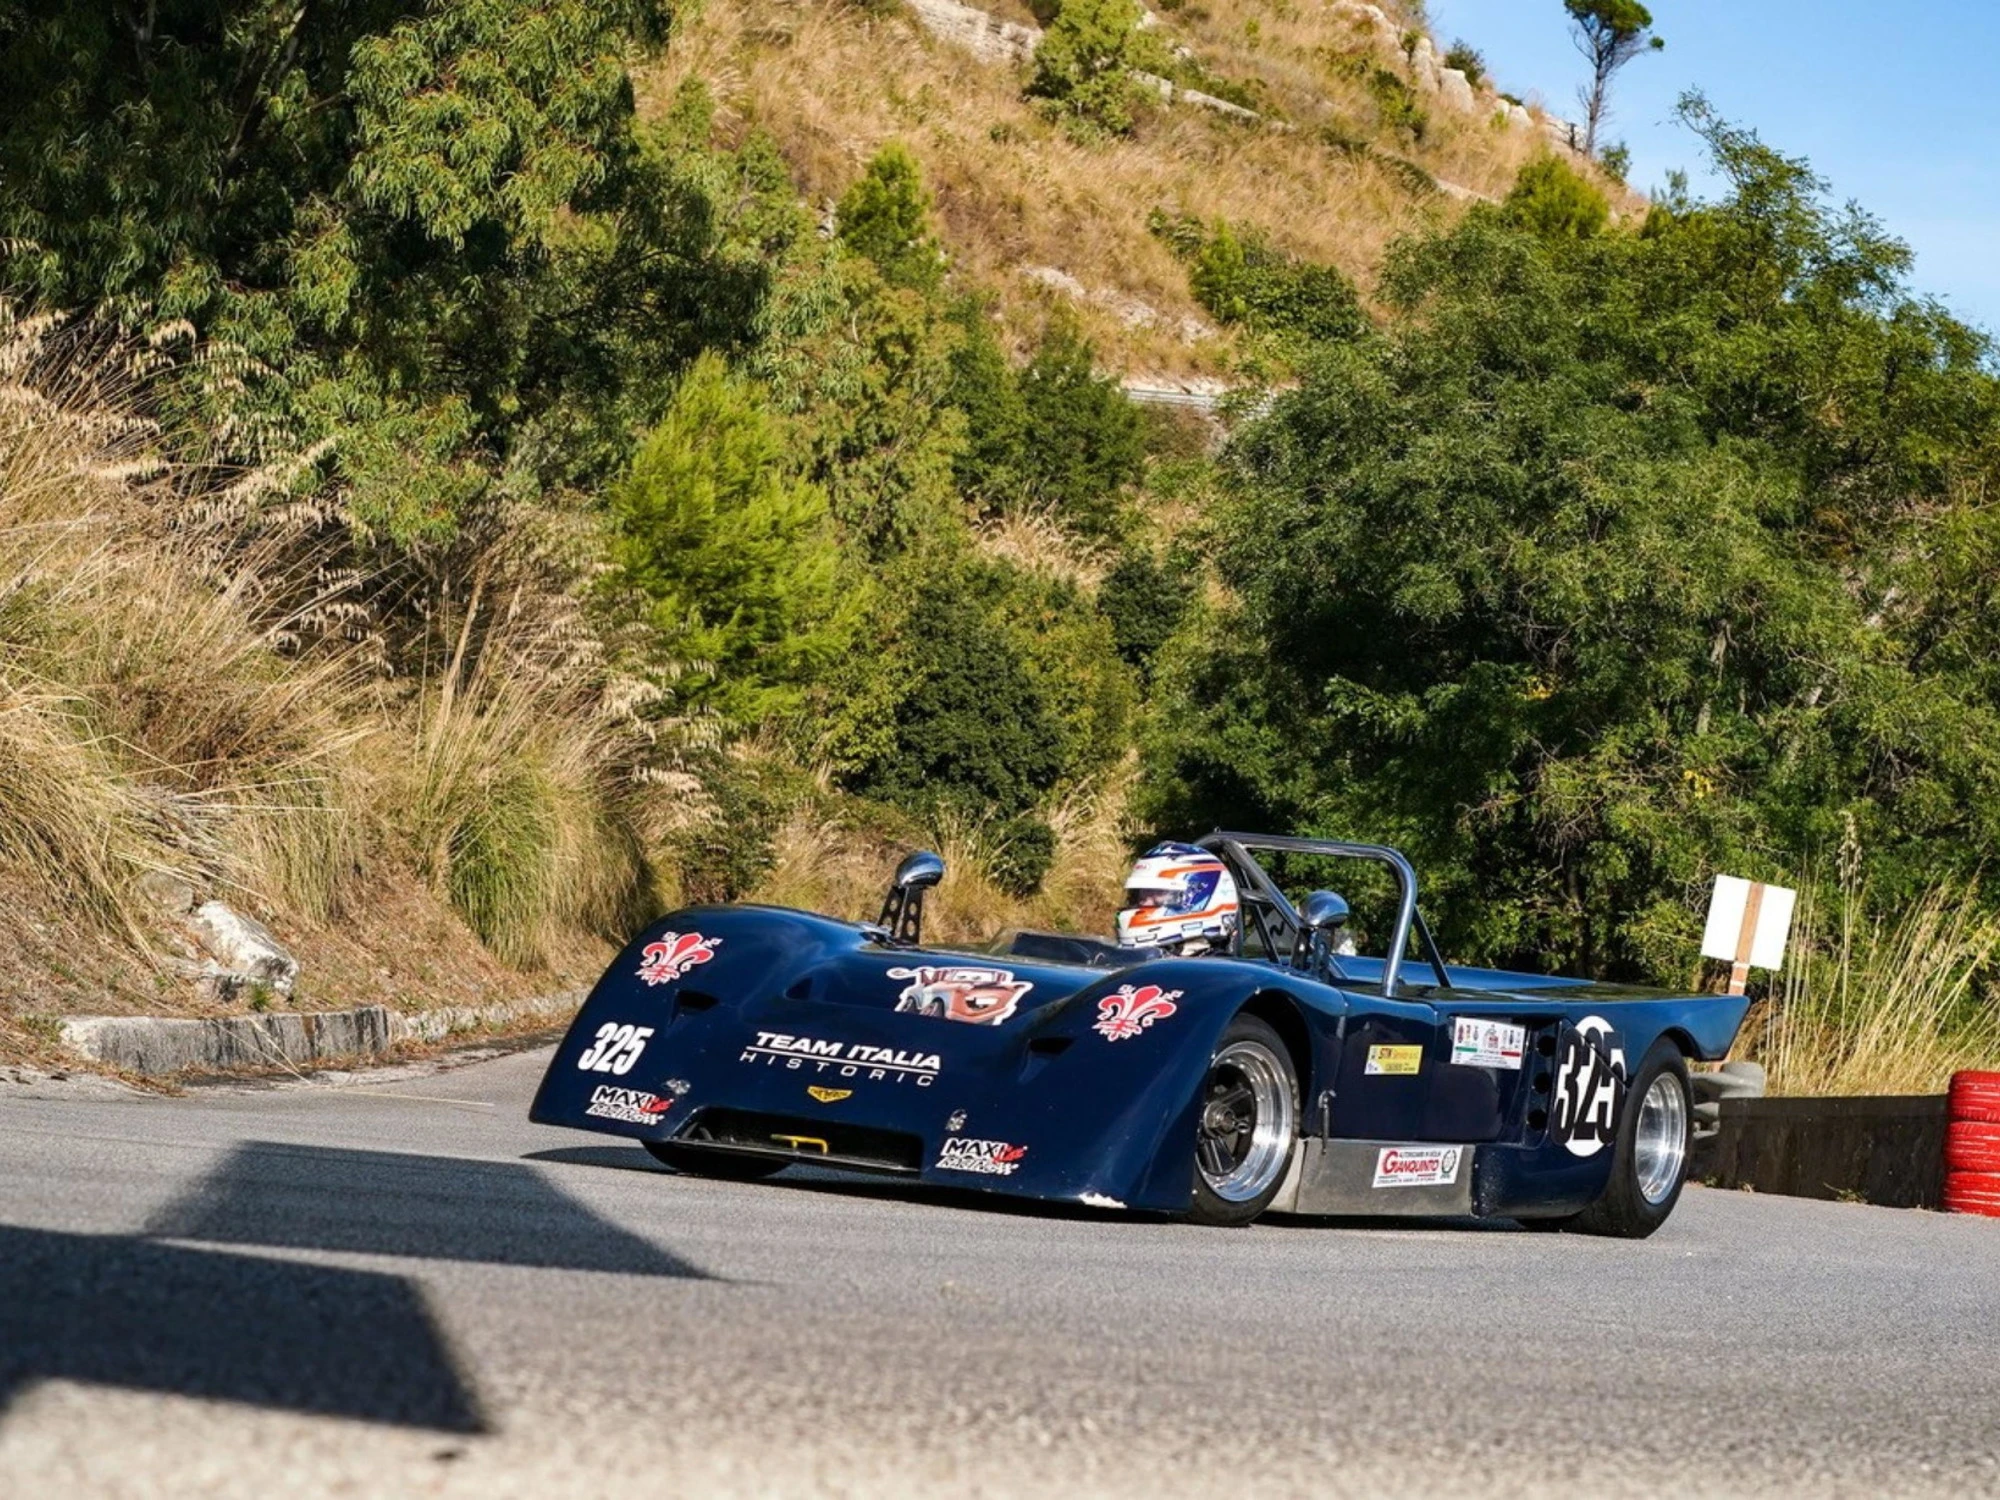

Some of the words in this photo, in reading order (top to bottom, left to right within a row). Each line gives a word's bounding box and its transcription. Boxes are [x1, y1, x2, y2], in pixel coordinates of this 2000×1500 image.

[577, 1021, 655, 1075] 325
[756, 1031, 843, 1056] TEAM
[847, 1045, 941, 1070] ITALIA
[739, 1051, 934, 1087] HISTORIC
[1551, 1026, 1626, 1146] 325
[593, 1086, 656, 1109] MAXI
[944, 1138, 1006, 1161] MAXI
